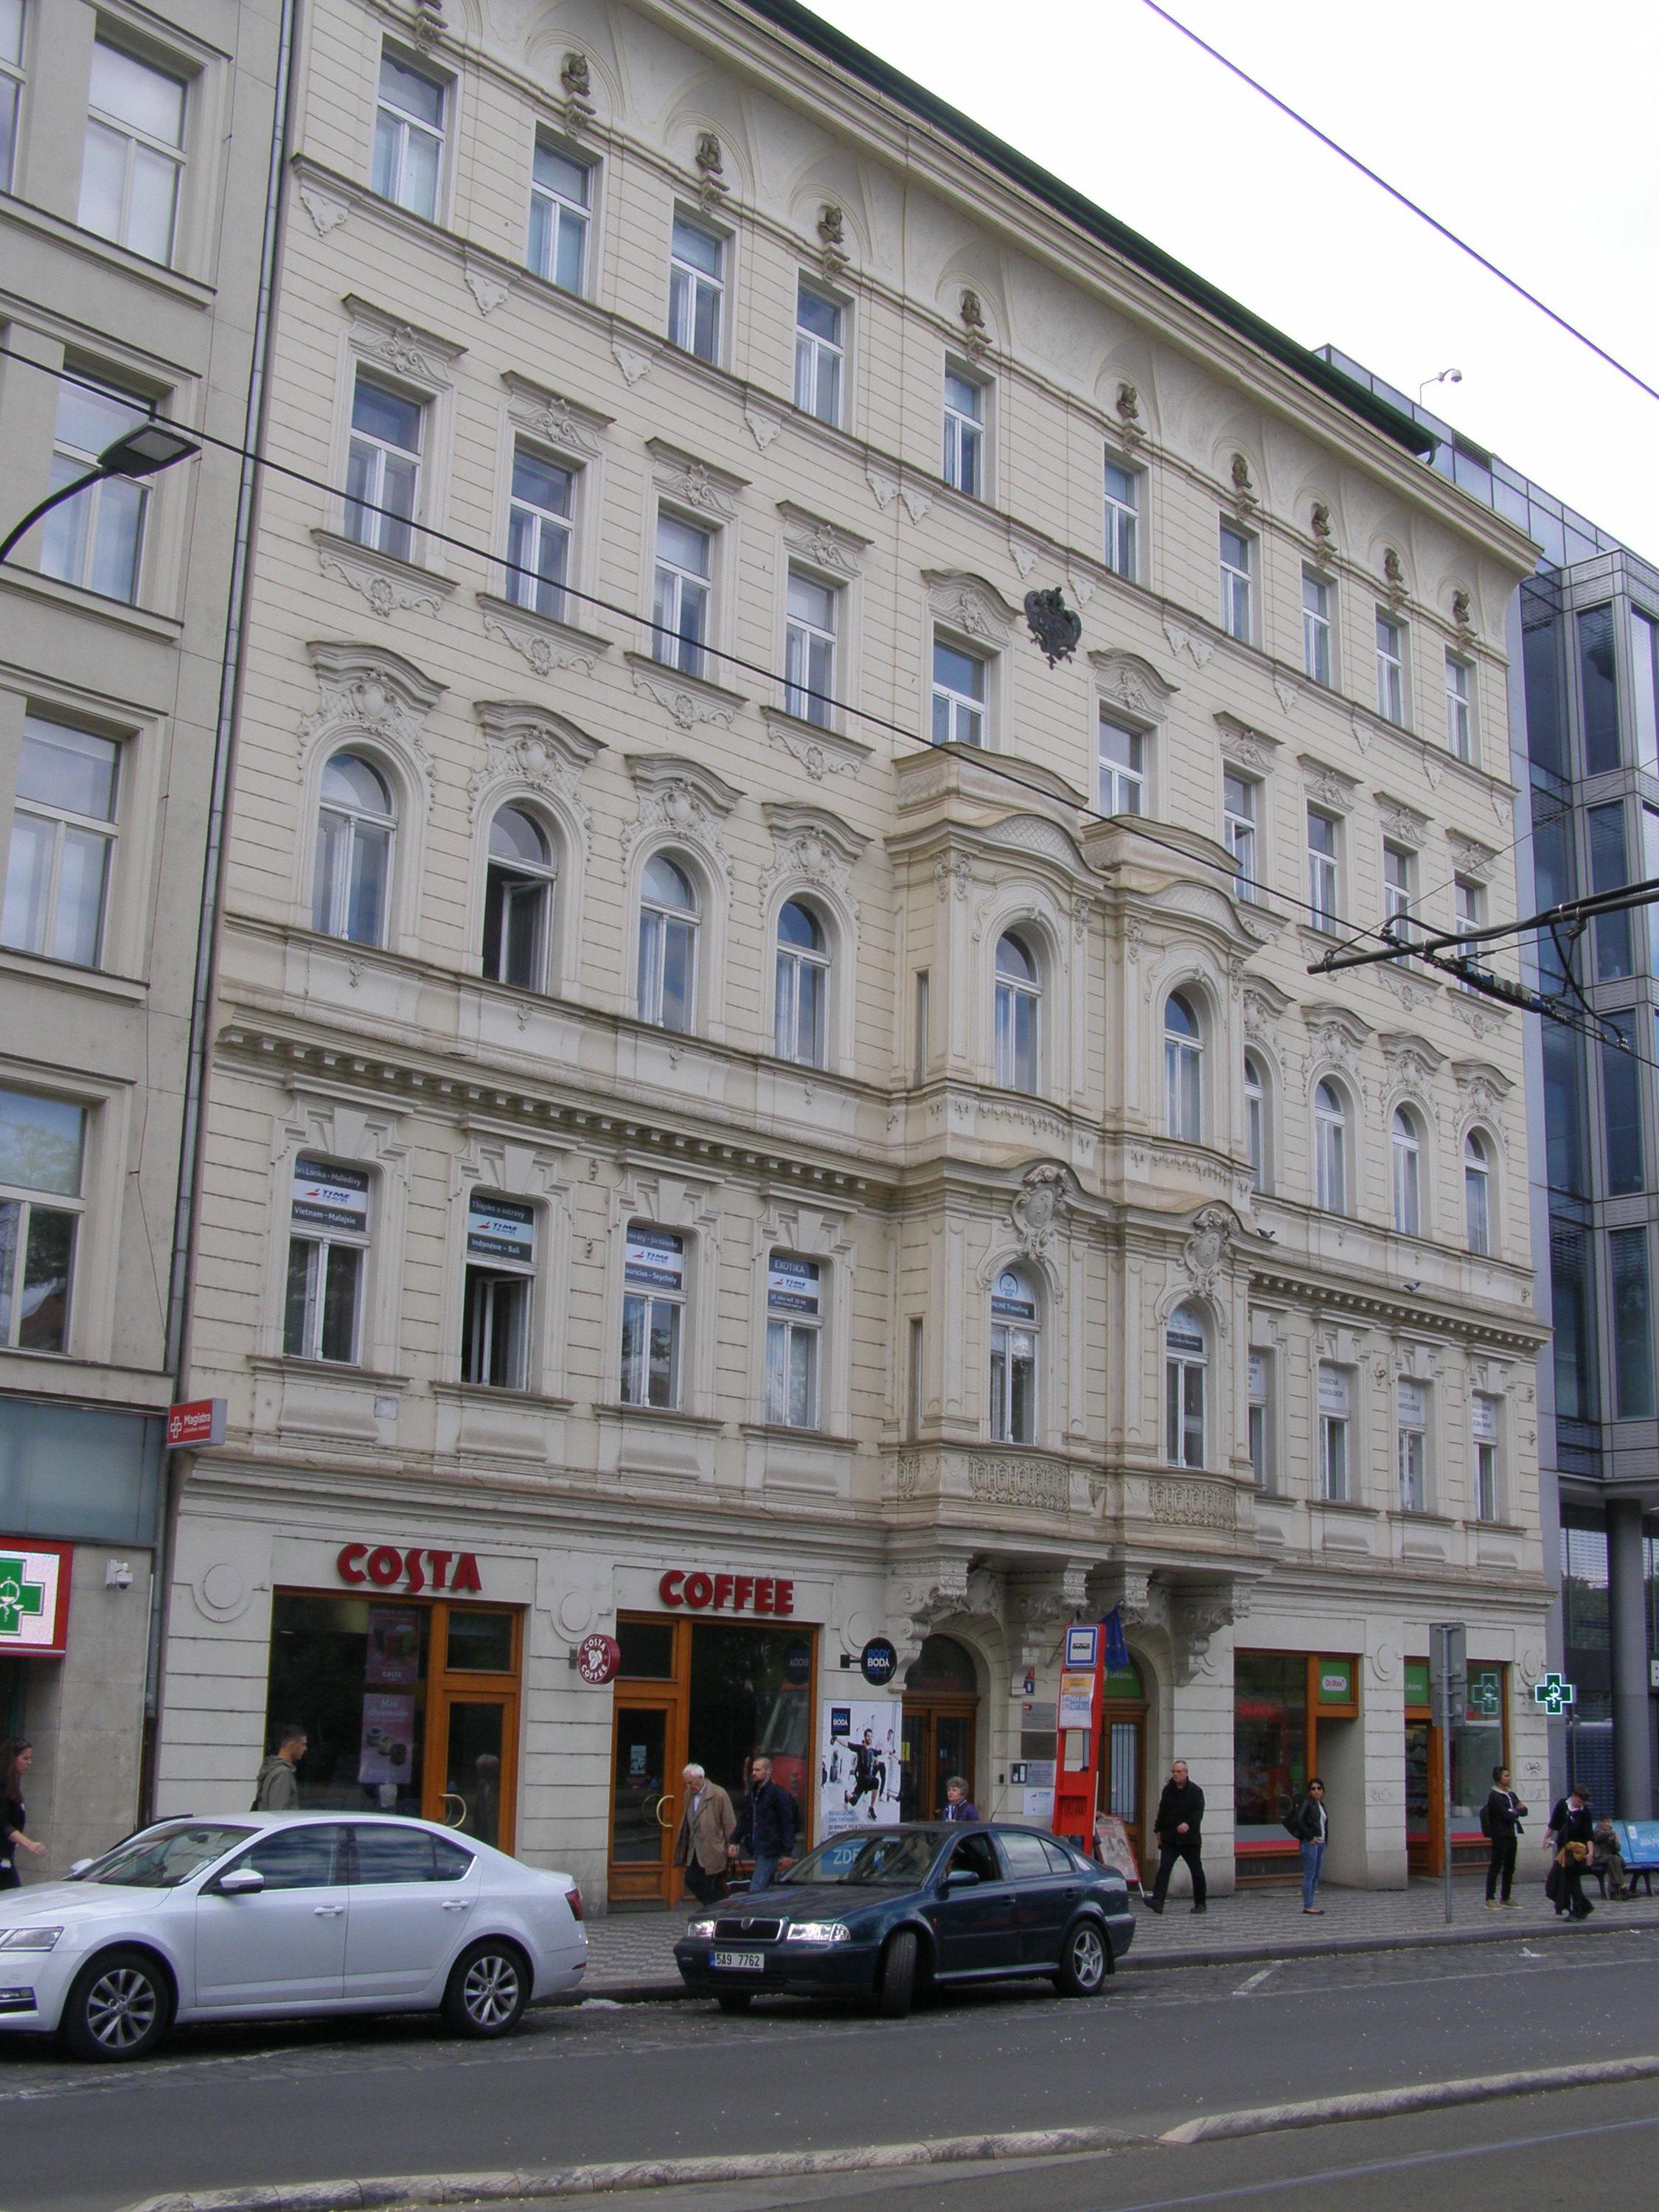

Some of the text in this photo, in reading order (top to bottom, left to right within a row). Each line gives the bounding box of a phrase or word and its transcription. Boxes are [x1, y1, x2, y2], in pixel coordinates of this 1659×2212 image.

[306, 1169, 326, 1178] Lanka
[331, 1173, 361, 1187] Maledivy
[323, 1189, 350, 1199] TIME
[294, 1206, 323, 1218] Vietnam
[328, 1213, 356, 1225] Malajsie
[472, 1200, 495, 1212] Thajsko
[501, 1208, 525, 1220] ostrovy
[493, 1222, 518, 1231] TIME
[472, 1239, 501, 1251] Indonésie
[508, 1245, 520, 1254] Bali
[647, 1252, 669, 1260] TIME
[775, 1260, 805, 1274] EXOTIKA
[625, 1268, 647, 1278] auricius
[653, 1272, 677, 1284] Seychely
[184, 1413, 211, 1426] Magistra
[337, 1543, 482, 1593] COSTA
[659, 1570, 794, 1614] COFFEE
[584, 1638, 606, 1652] COSTA
[868, 1649, 890, 1658] BODY
[382, 1671, 402, 1679] COSTA
[582, 1664, 608, 1680] COFFEE
[716, 1954, 760, 1966] 5A9 7762
